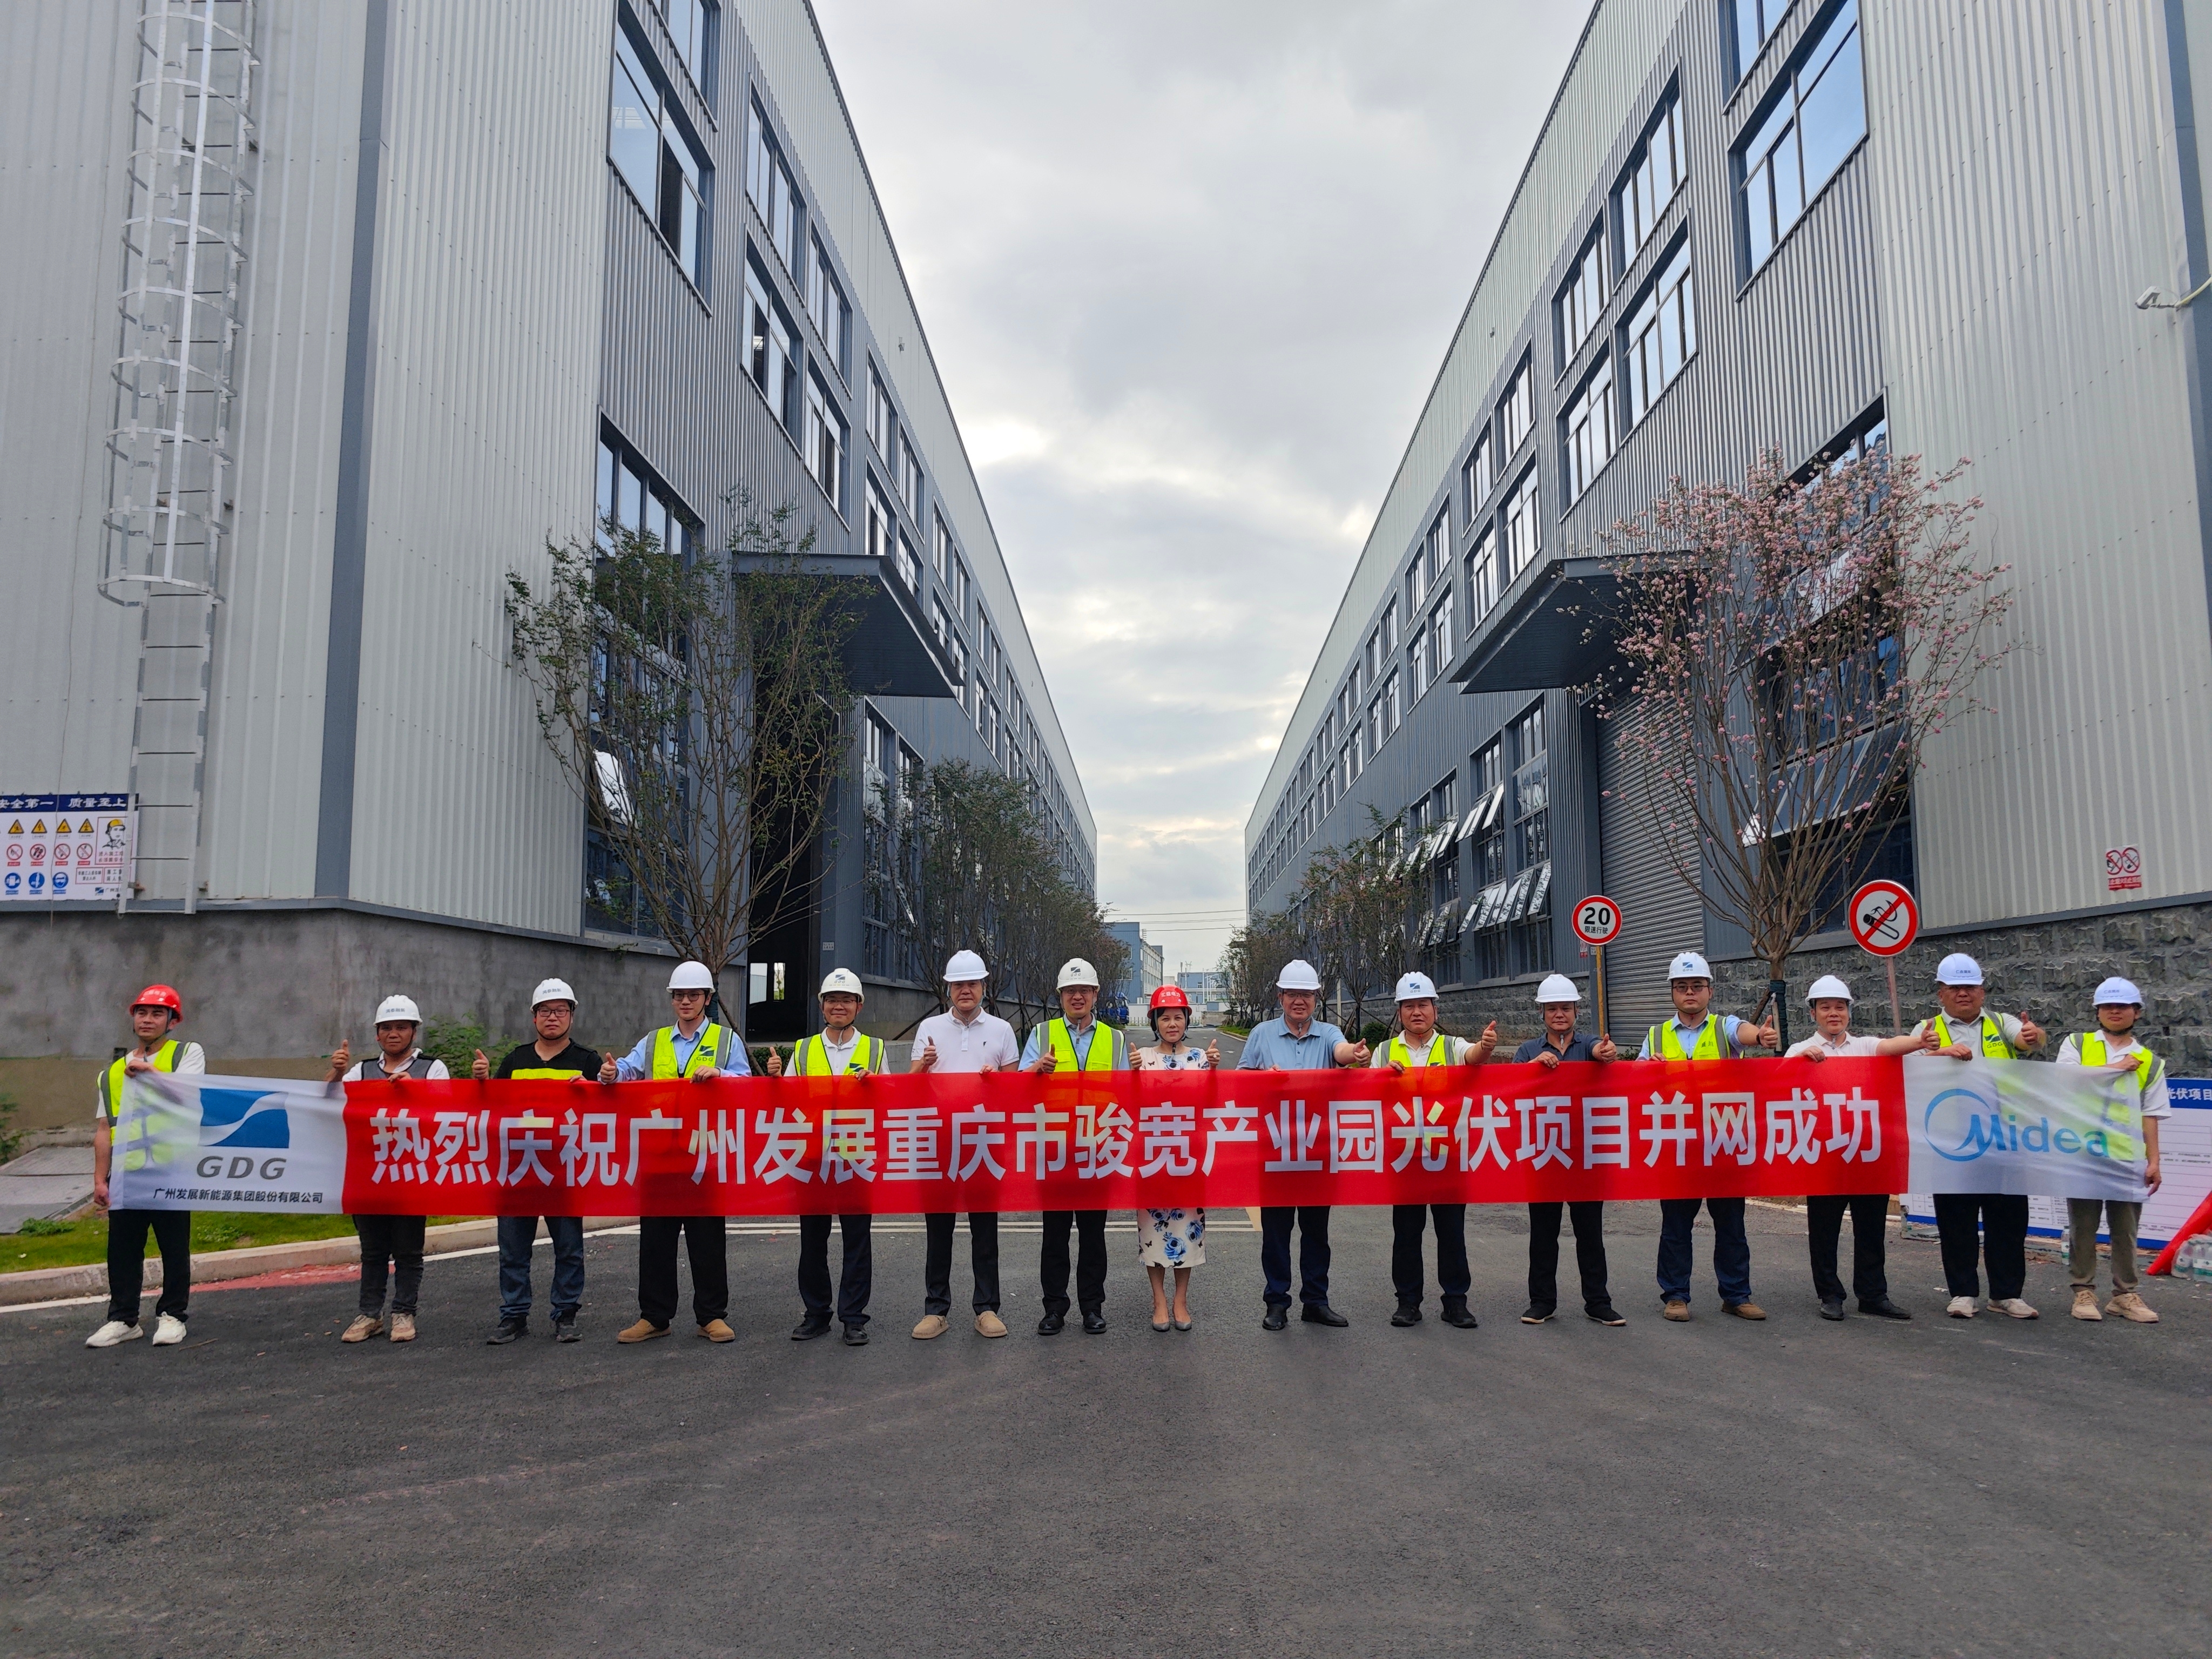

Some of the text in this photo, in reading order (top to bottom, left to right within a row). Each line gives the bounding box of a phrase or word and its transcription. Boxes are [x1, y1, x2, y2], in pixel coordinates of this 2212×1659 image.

[0, 797, 126, 809] 安全第一 质量至上
[1584, 907, 1610, 925] 20
[1584, 926, 1608, 934] 限速行驶
[369, 1087, 1881, 1187] 热烈庆祝广州发展重庆市骏宽产业园光伏项目并网成功
[1951, 1111, 2110, 1161] Midea
[196, 1155, 287, 1180] GDG
[153, 1188, 323, 1204] 广州发展新能源集团股份有限公司
